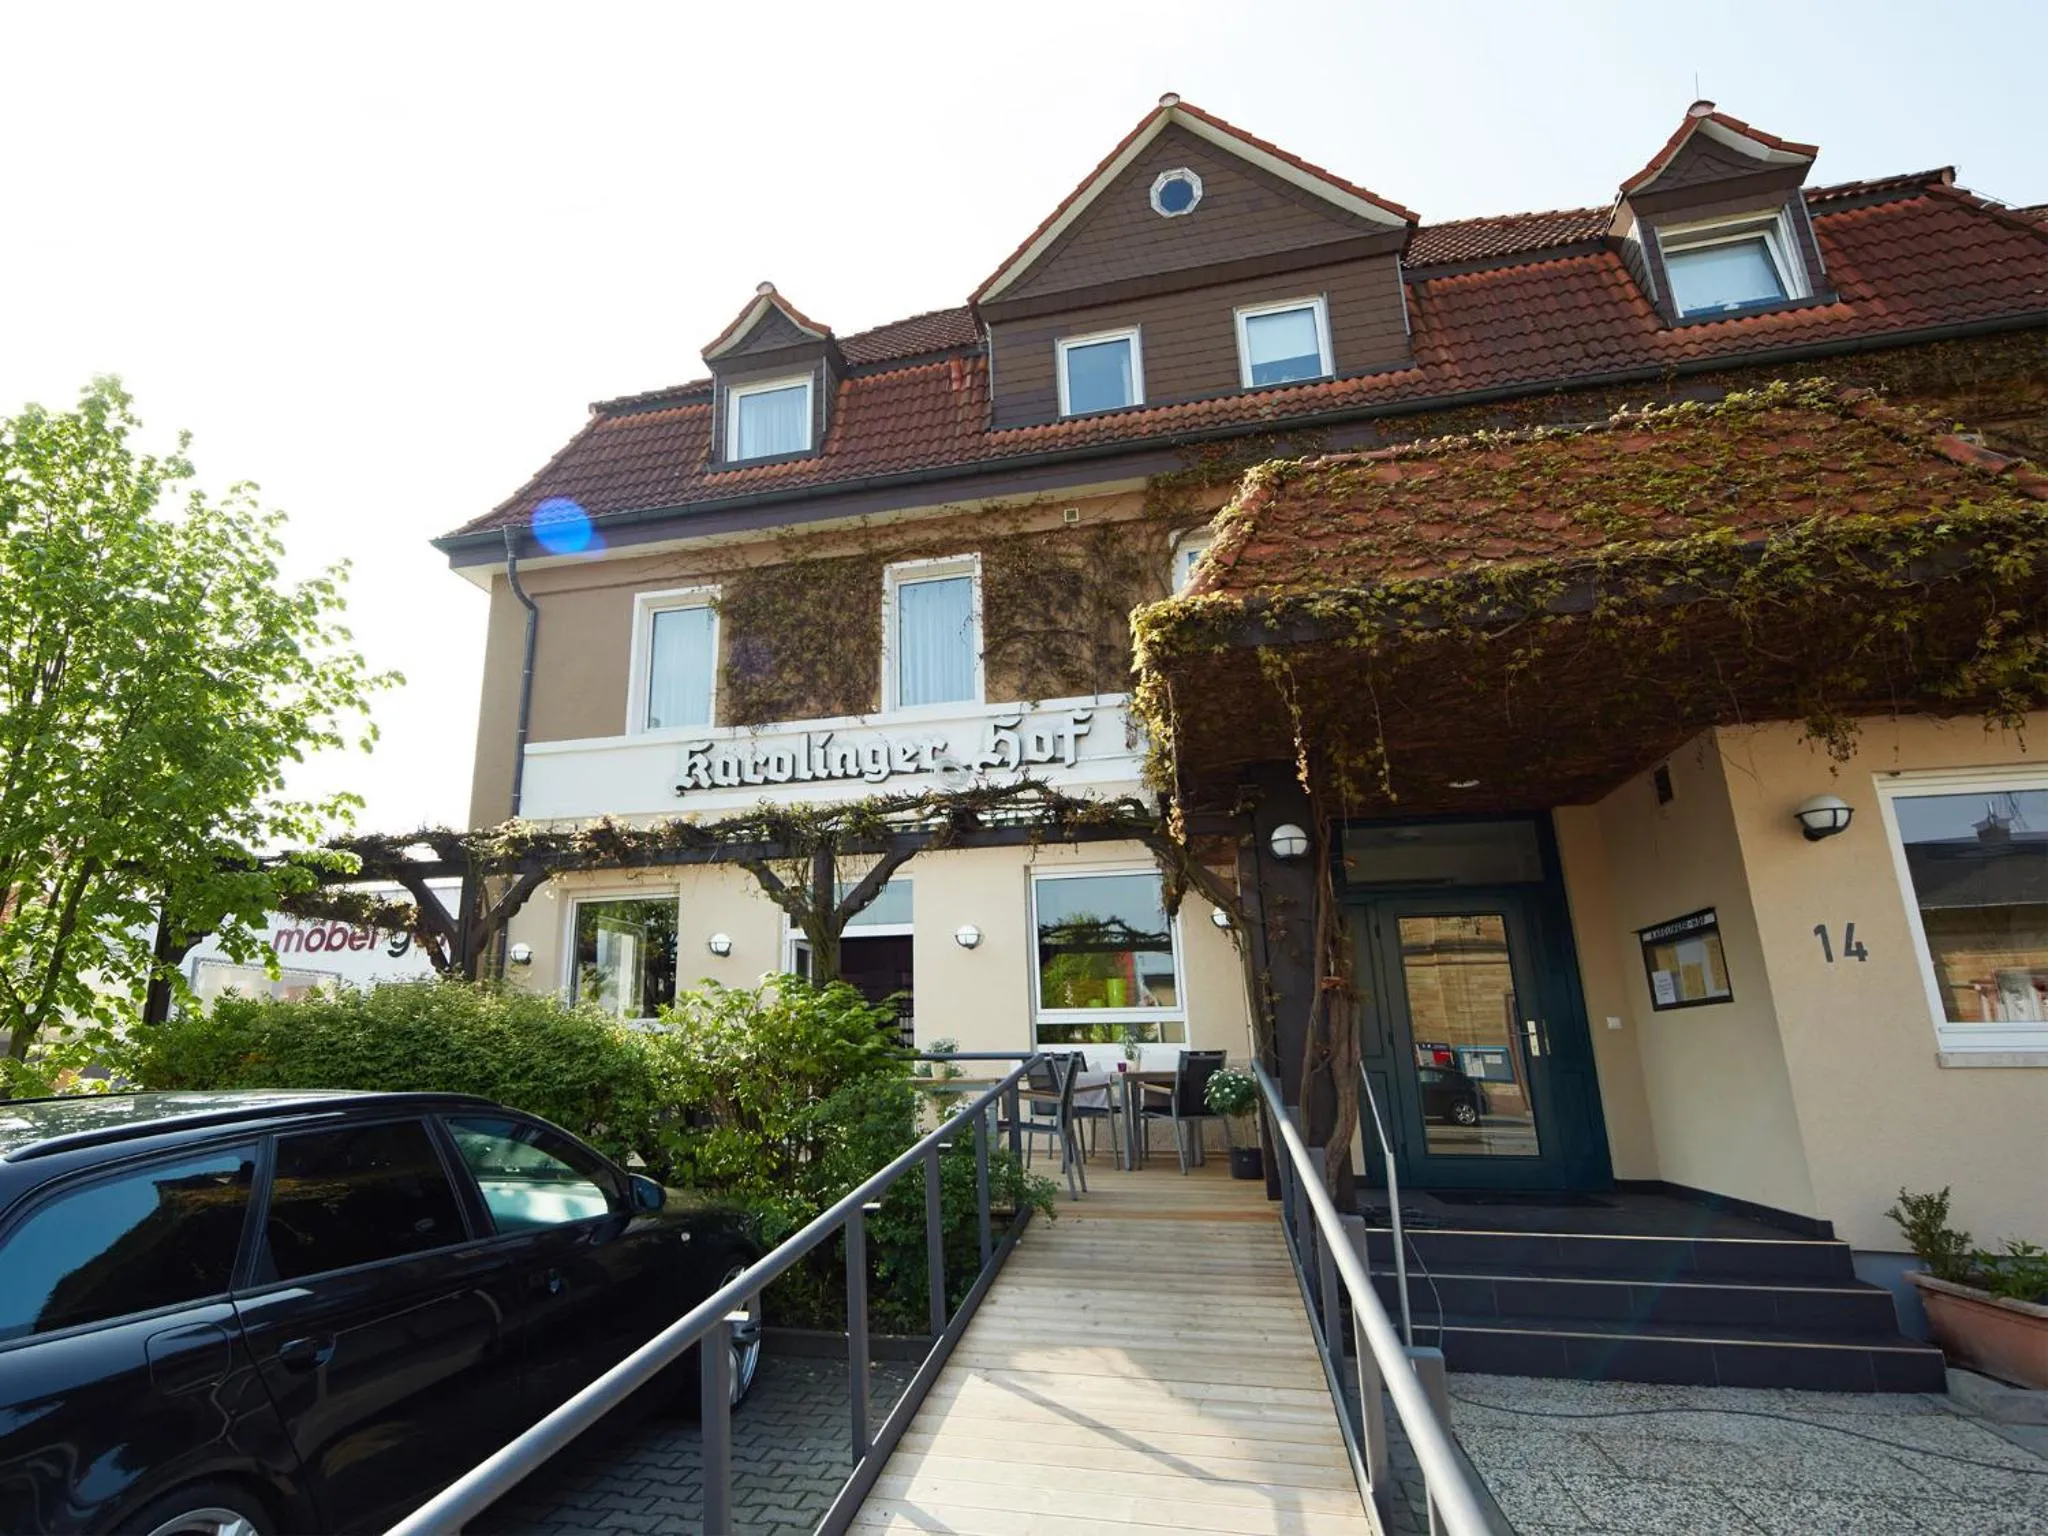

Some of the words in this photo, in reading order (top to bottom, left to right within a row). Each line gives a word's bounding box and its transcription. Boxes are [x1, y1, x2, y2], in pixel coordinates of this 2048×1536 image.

[676, 731, 948, 797] Karolinger
[972, 708, 1094, 773] Hof
[1813, 922, 1869, 962] 14
